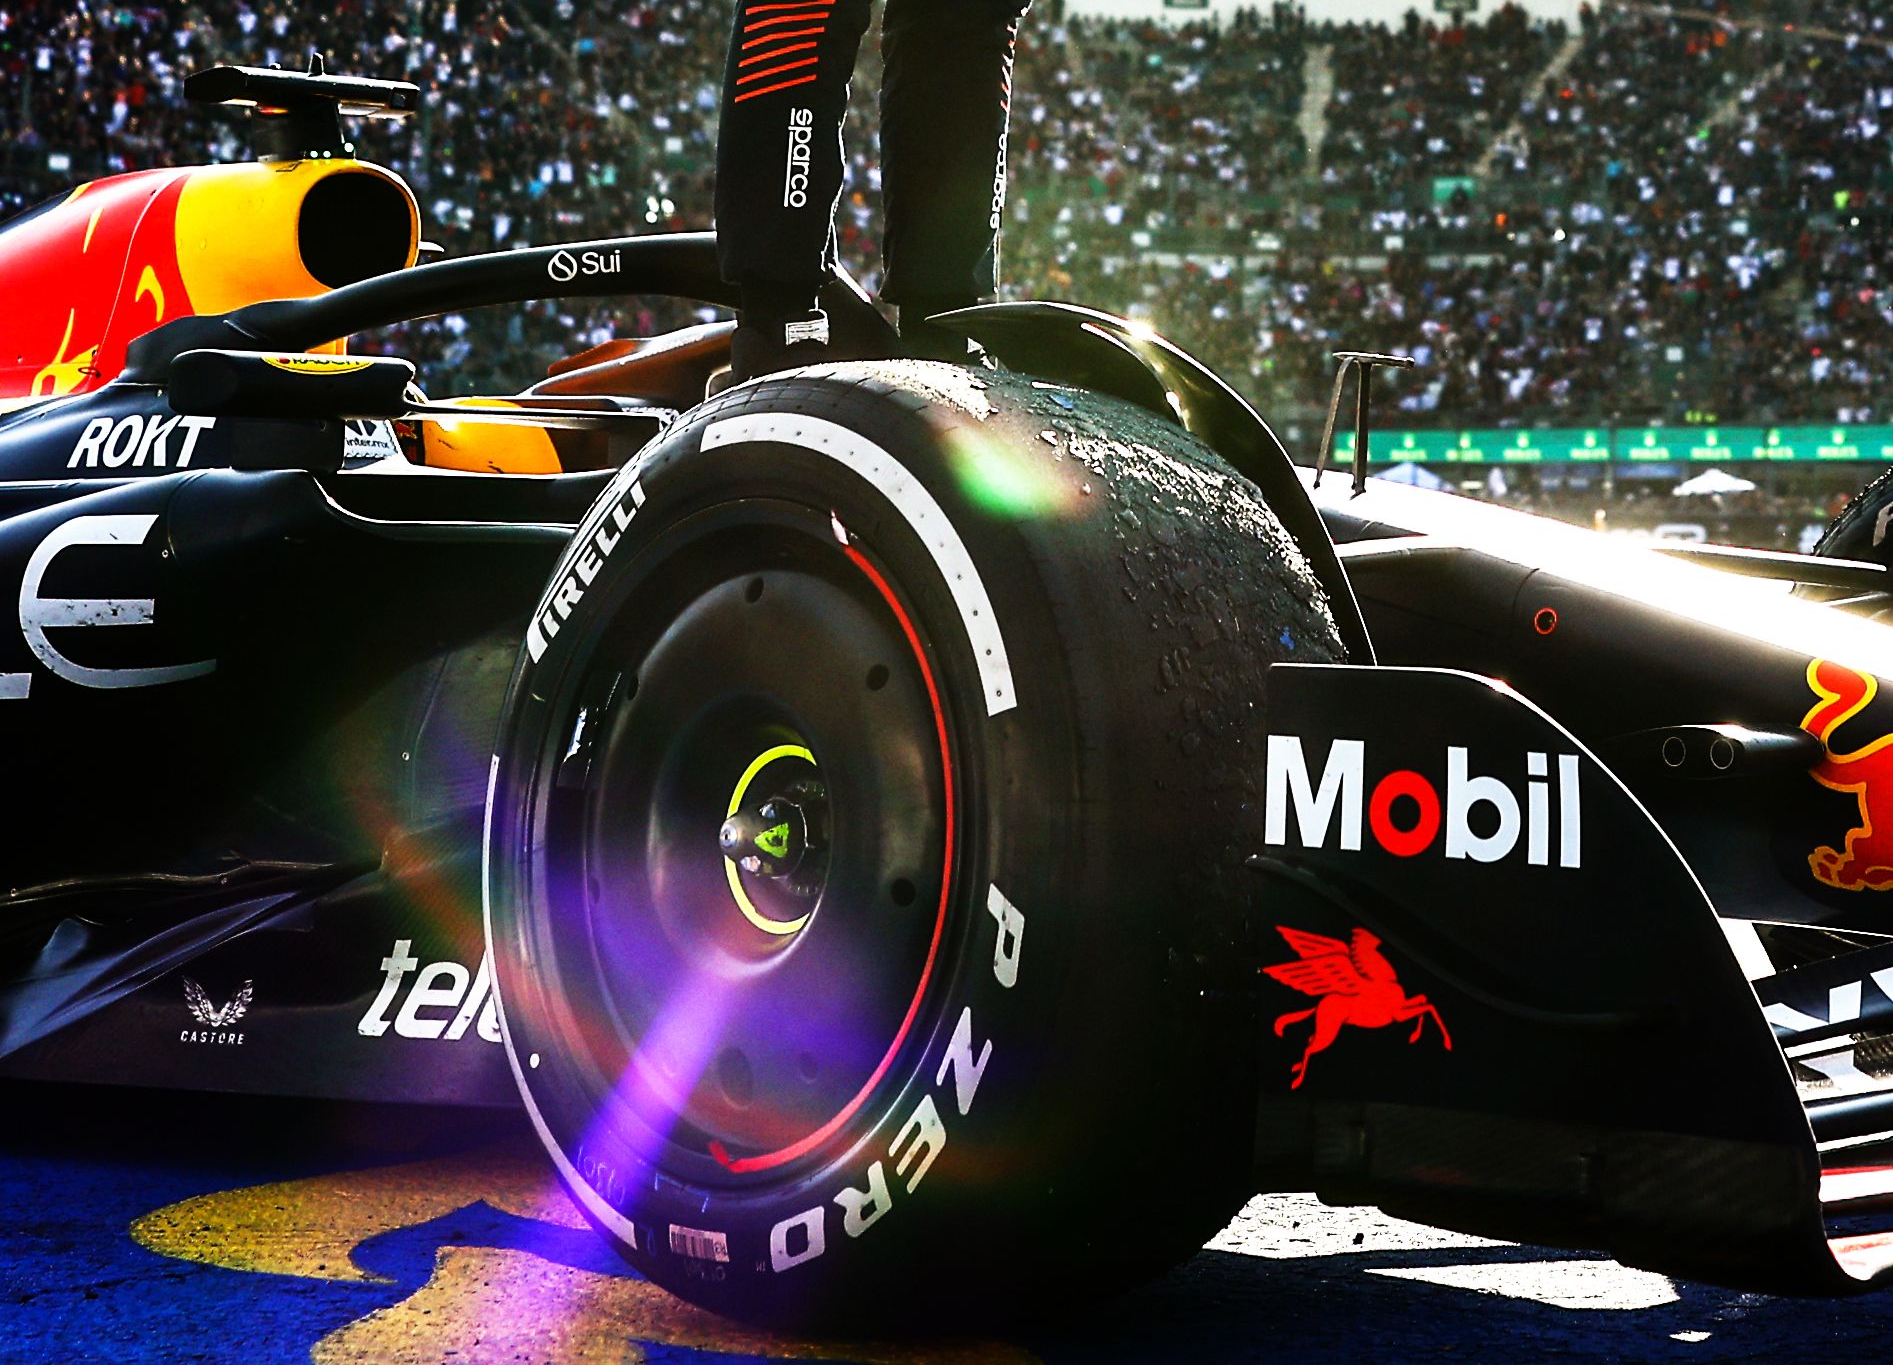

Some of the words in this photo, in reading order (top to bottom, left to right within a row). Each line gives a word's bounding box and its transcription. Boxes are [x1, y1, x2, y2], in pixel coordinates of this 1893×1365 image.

[784, 108, 813, 208] sparco
[990, 133, 1007, 229] sparco
[581, 249, 621, 275] Sui
[66, 414, 217, 468] ROKT
[527, 469, 647, 664] PIRELLI
[1264, 734, 1581, 869] Mobil
[987, 882, 1025, 988] P
[180, 1030, 245, 1045] CASTORE
[769, 1006, 993, 1273] ZERO
